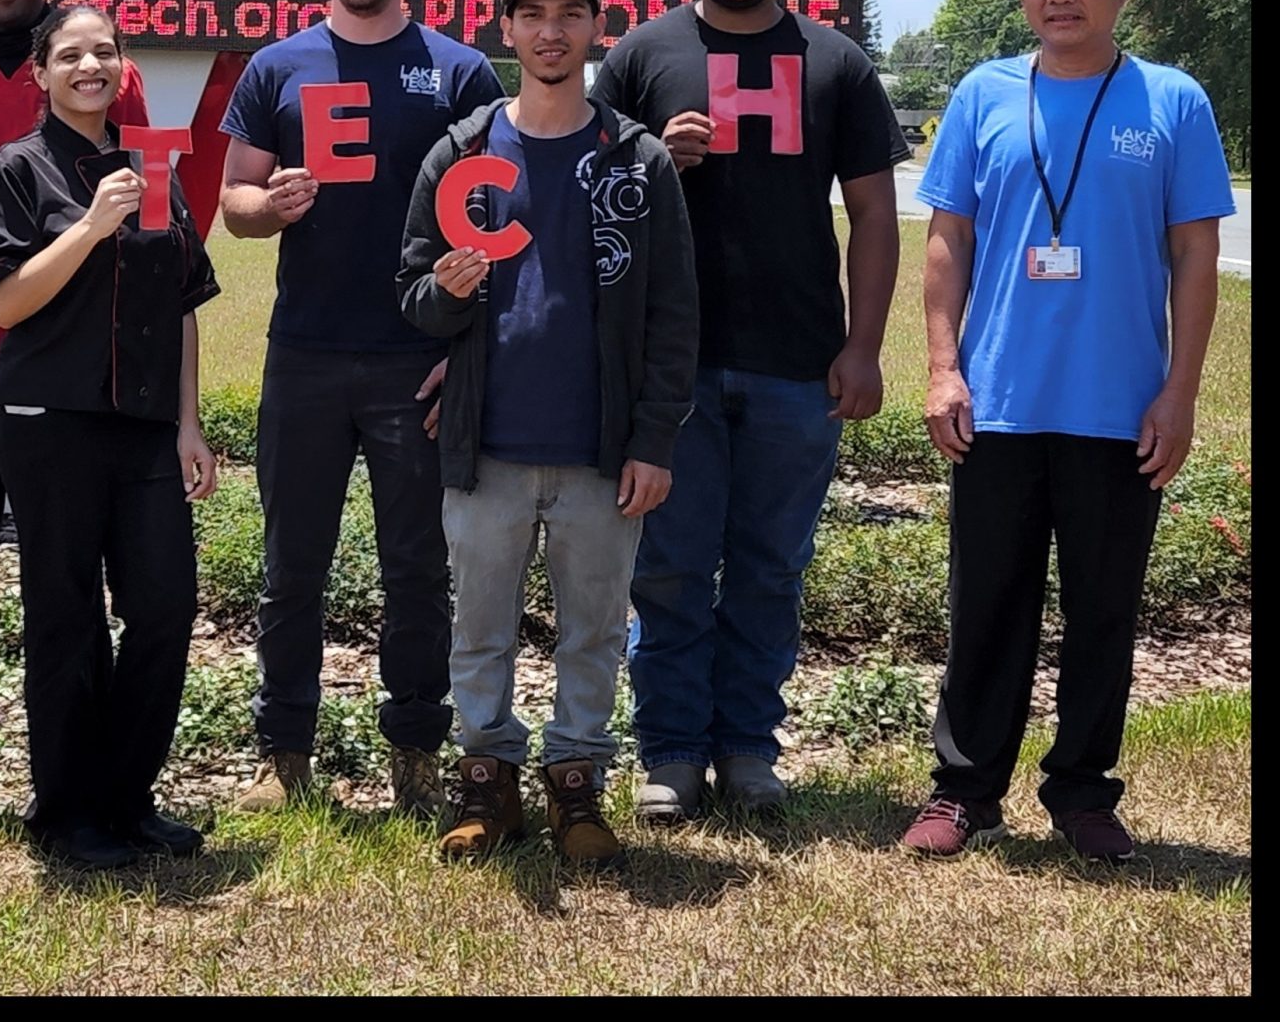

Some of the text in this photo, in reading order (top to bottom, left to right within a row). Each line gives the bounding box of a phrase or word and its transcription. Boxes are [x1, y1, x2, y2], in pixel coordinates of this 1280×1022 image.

[400, 64, 441, 80] LAKE
[401, 76, 441, 92] TECH
[300, 82, 376, 183] E
[707, 53, 803, 155] H
[1111, 125, 1157, 147] LAKE
[1112, 135, 1156, 161] TECH
[120, 125, 193, 231] T
[435, 155, 532, 261] C
